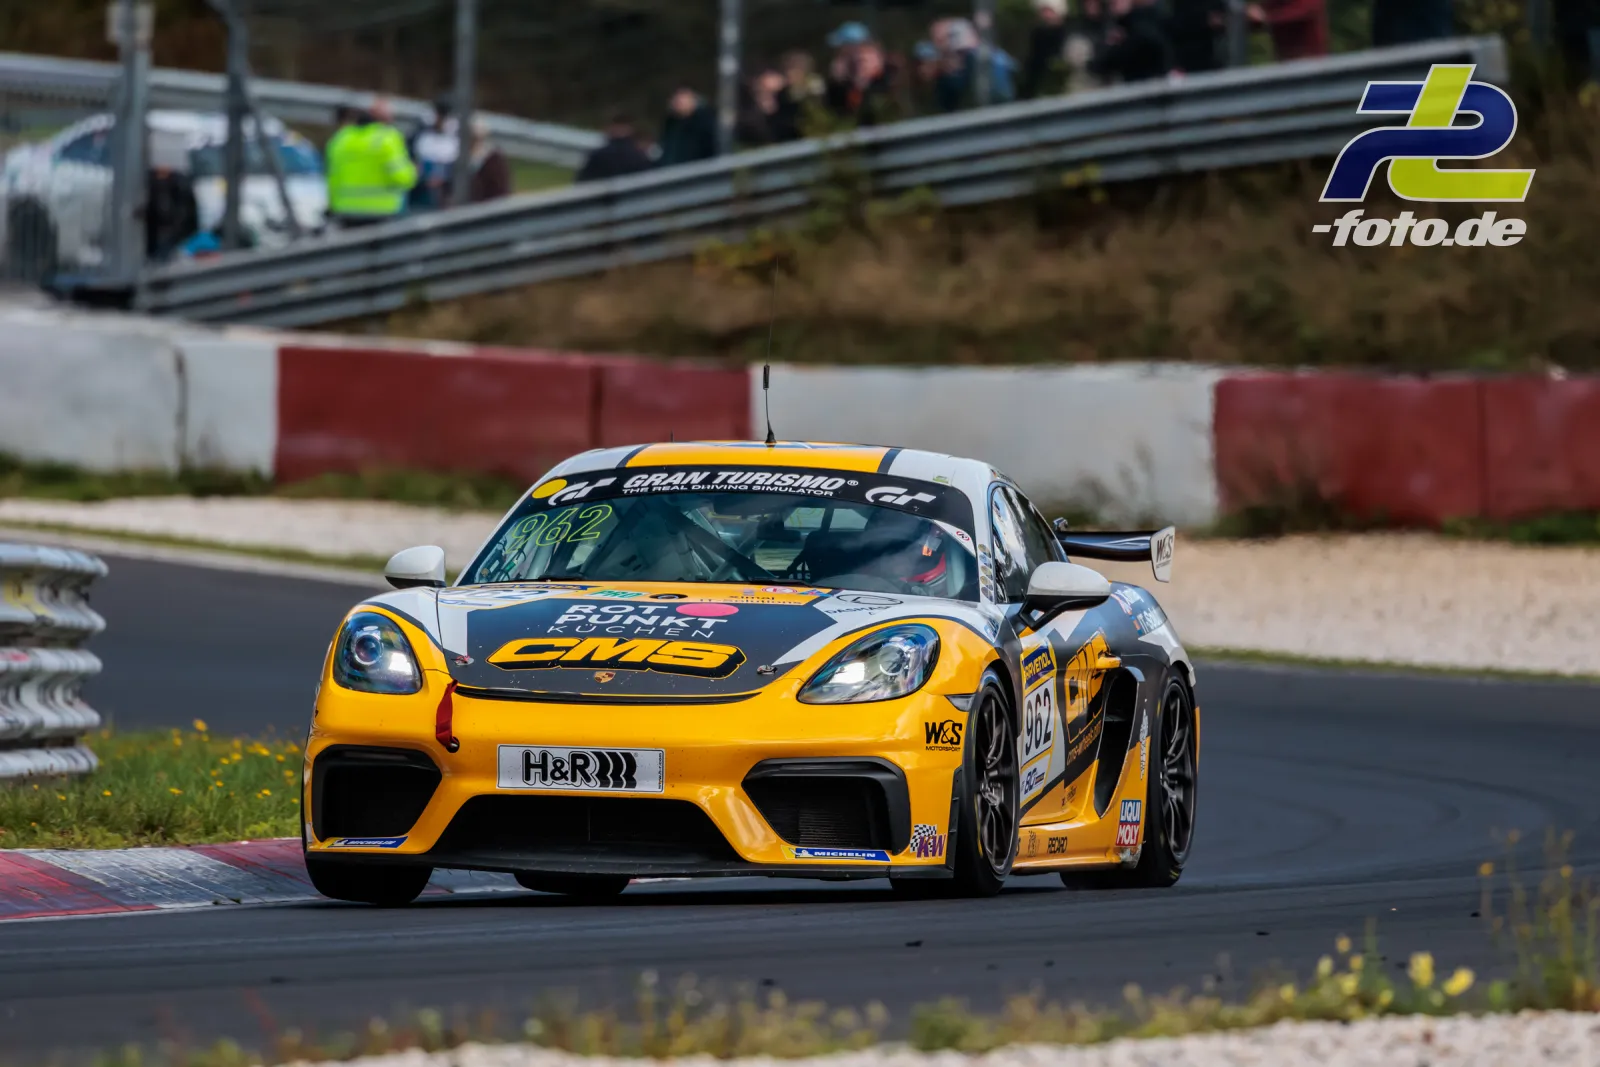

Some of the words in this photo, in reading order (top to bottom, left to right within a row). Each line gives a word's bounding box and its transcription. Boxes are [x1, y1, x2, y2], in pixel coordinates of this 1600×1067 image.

[623, 472, 711, 488] GRAN
[622, 485, 649, 494] THE
[752, 485, 834, 497] SIMULATOR
[505, 504, 613, 554] 962
[565, 604, 669, 614] ROT
[546, 623, 715, 639] KÜCHEN
[554, 614, 729, 629] PUNKT
[486, 637, 747, 679] CMS
[1025, 687, 1052, 757] 962
[925, 720, 963, 746] W&S
[522, 750, 598, 787] H&R
[1120, 803, 1141, 822] LIQUI
[1117, 825, 1140, 846] MOLY
[916, 834, 947, 859] KW
